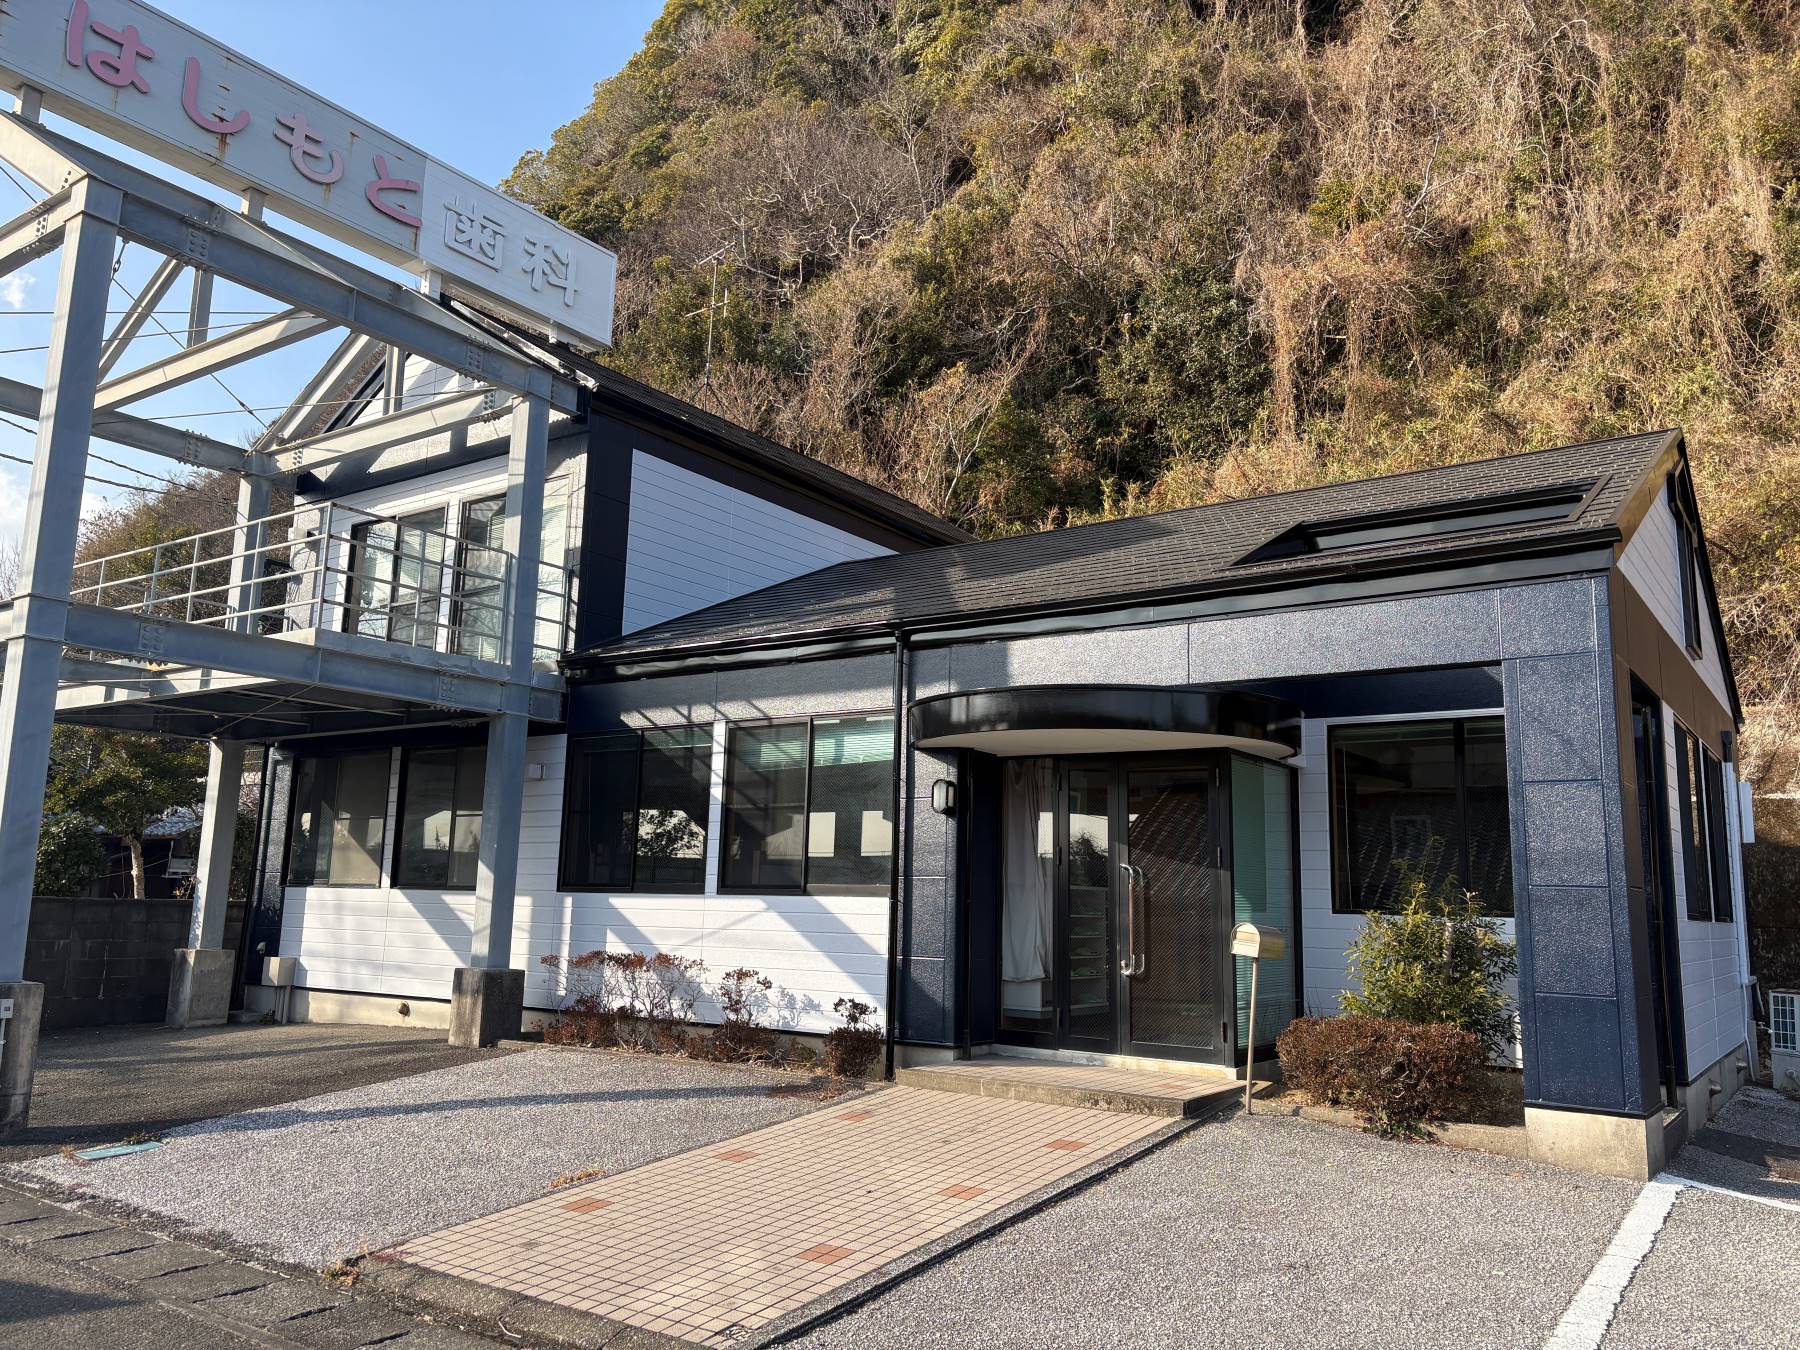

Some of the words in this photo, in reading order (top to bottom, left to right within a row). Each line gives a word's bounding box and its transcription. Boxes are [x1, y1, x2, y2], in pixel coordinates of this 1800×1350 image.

[65, 0, 579, 307] はしもと歯科
